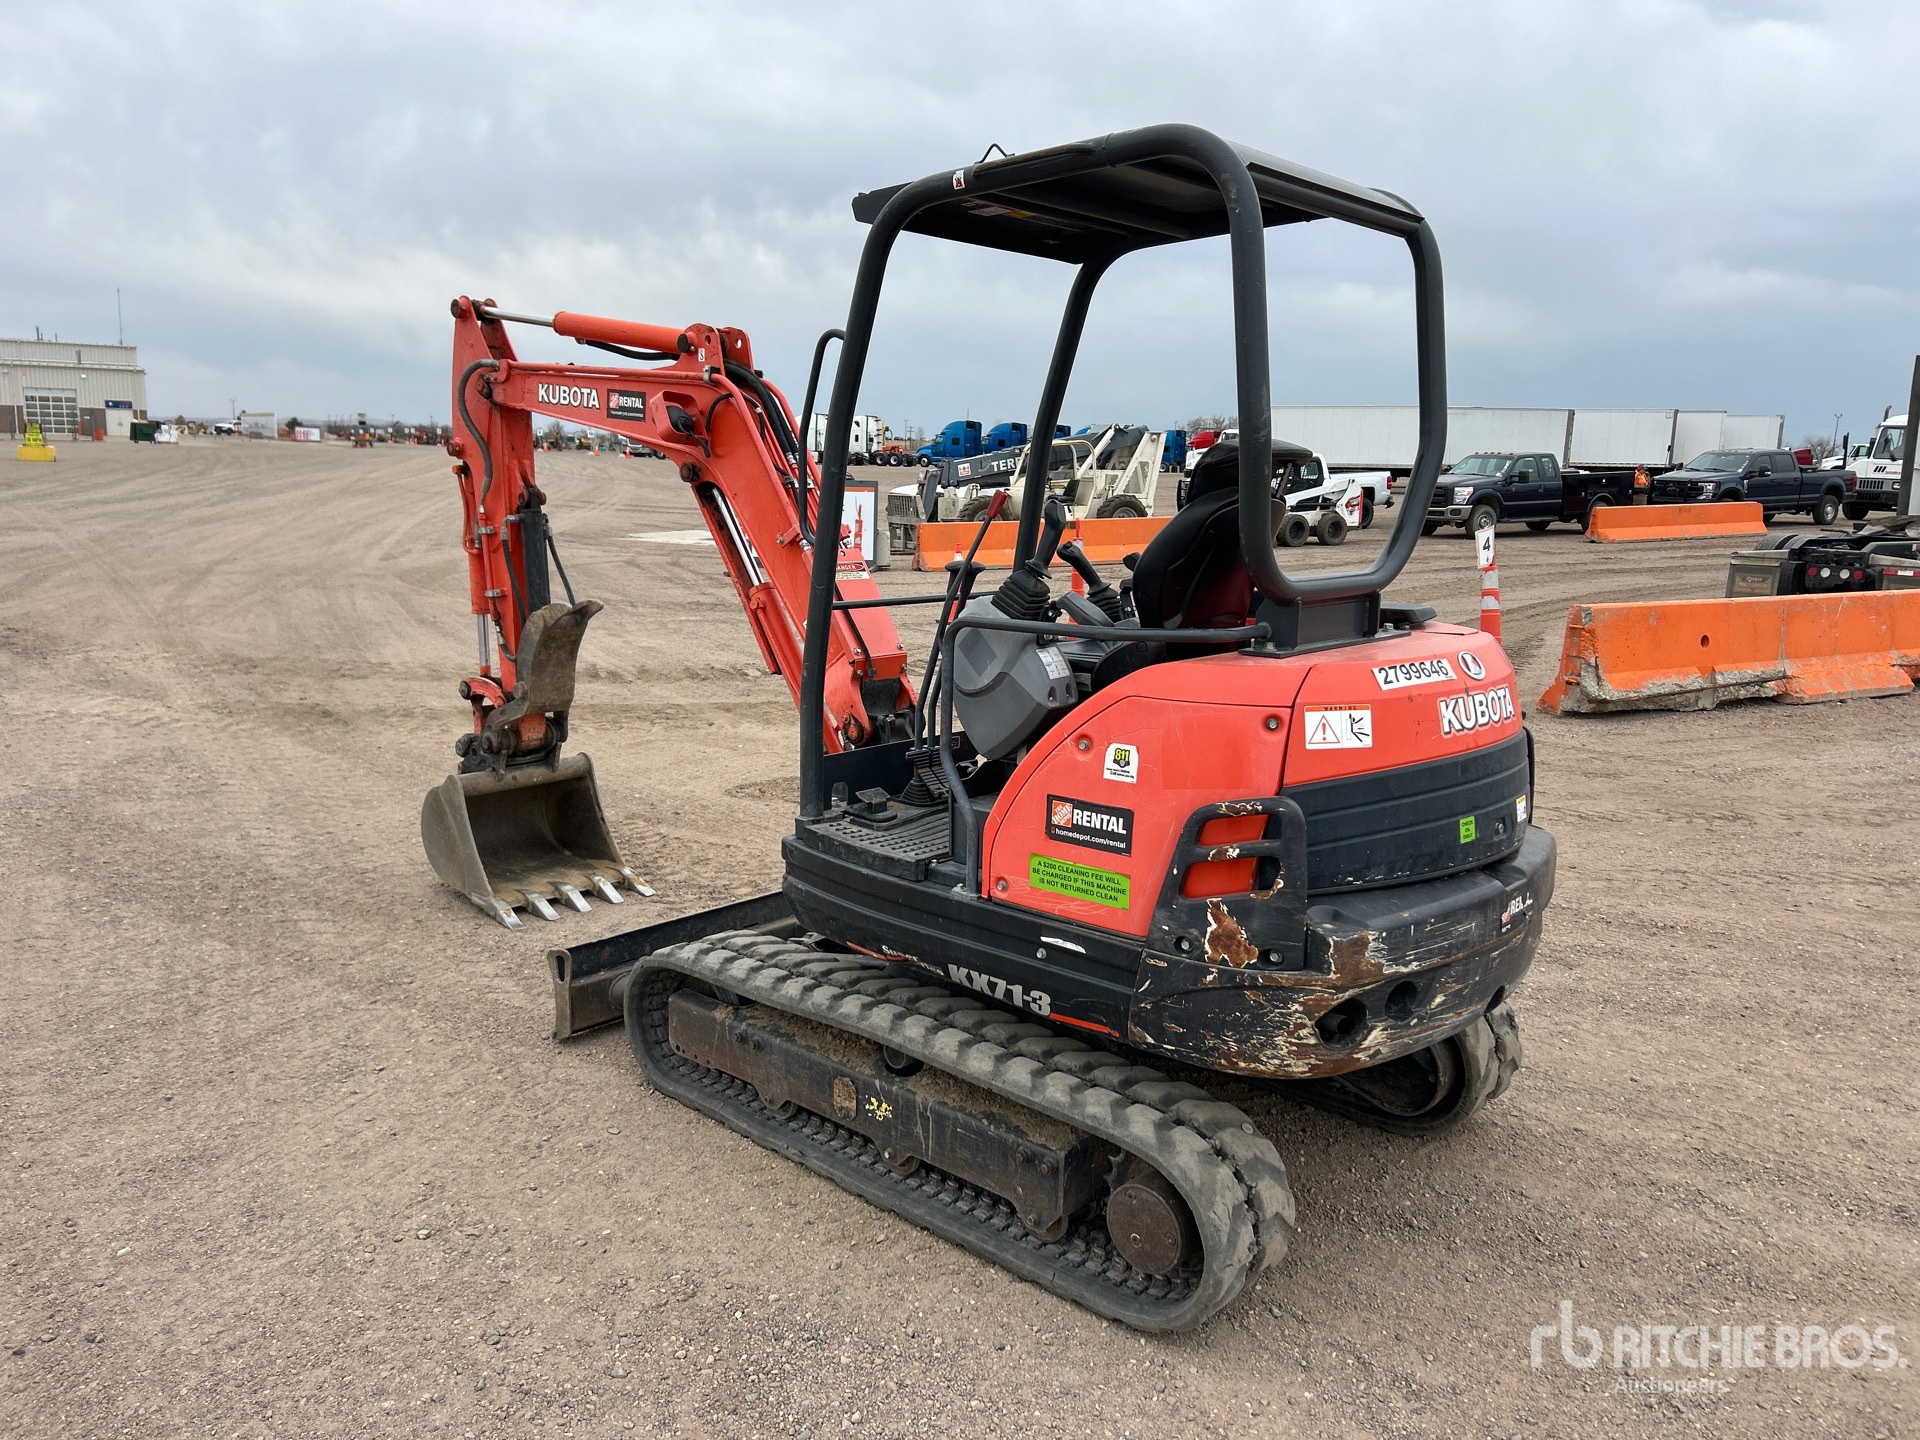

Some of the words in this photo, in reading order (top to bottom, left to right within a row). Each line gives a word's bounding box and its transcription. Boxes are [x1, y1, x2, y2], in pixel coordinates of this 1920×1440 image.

[538, 383, 600, 409] KUBOTA
[619, 396, 643, 409] RENTAL
[1482, 536, 1491, 551] 4
[1378, 660, 1449, 685] 2799646
[1439, 686, 1515, 735] KUBOTA
[1115, 748, 1130, 762] 811
[1073, 809, 1127, 834] RENTAL
[1056, 828, 1126, 848] homedepot.com/rental
[1042, 870, 1072, 882] CHARGED
[1080, 878, 1094, 888] THIS
[1096, 883, 1126, 895] MACHINE
[1043, 862, 1056, 870] $200
[1058, 866, 1090, 878] CLEANING
[1091, 873, 1104, 881] FEE
[1106, 876, 1121, 885] WILL
[1046, 879, 1059, 888] NOT
[1060, 882, 1094, 896] RETURNED
[1096, 892, 1118, 902] CLEAN
[948, 964, 1051, 1016] KX71-3
